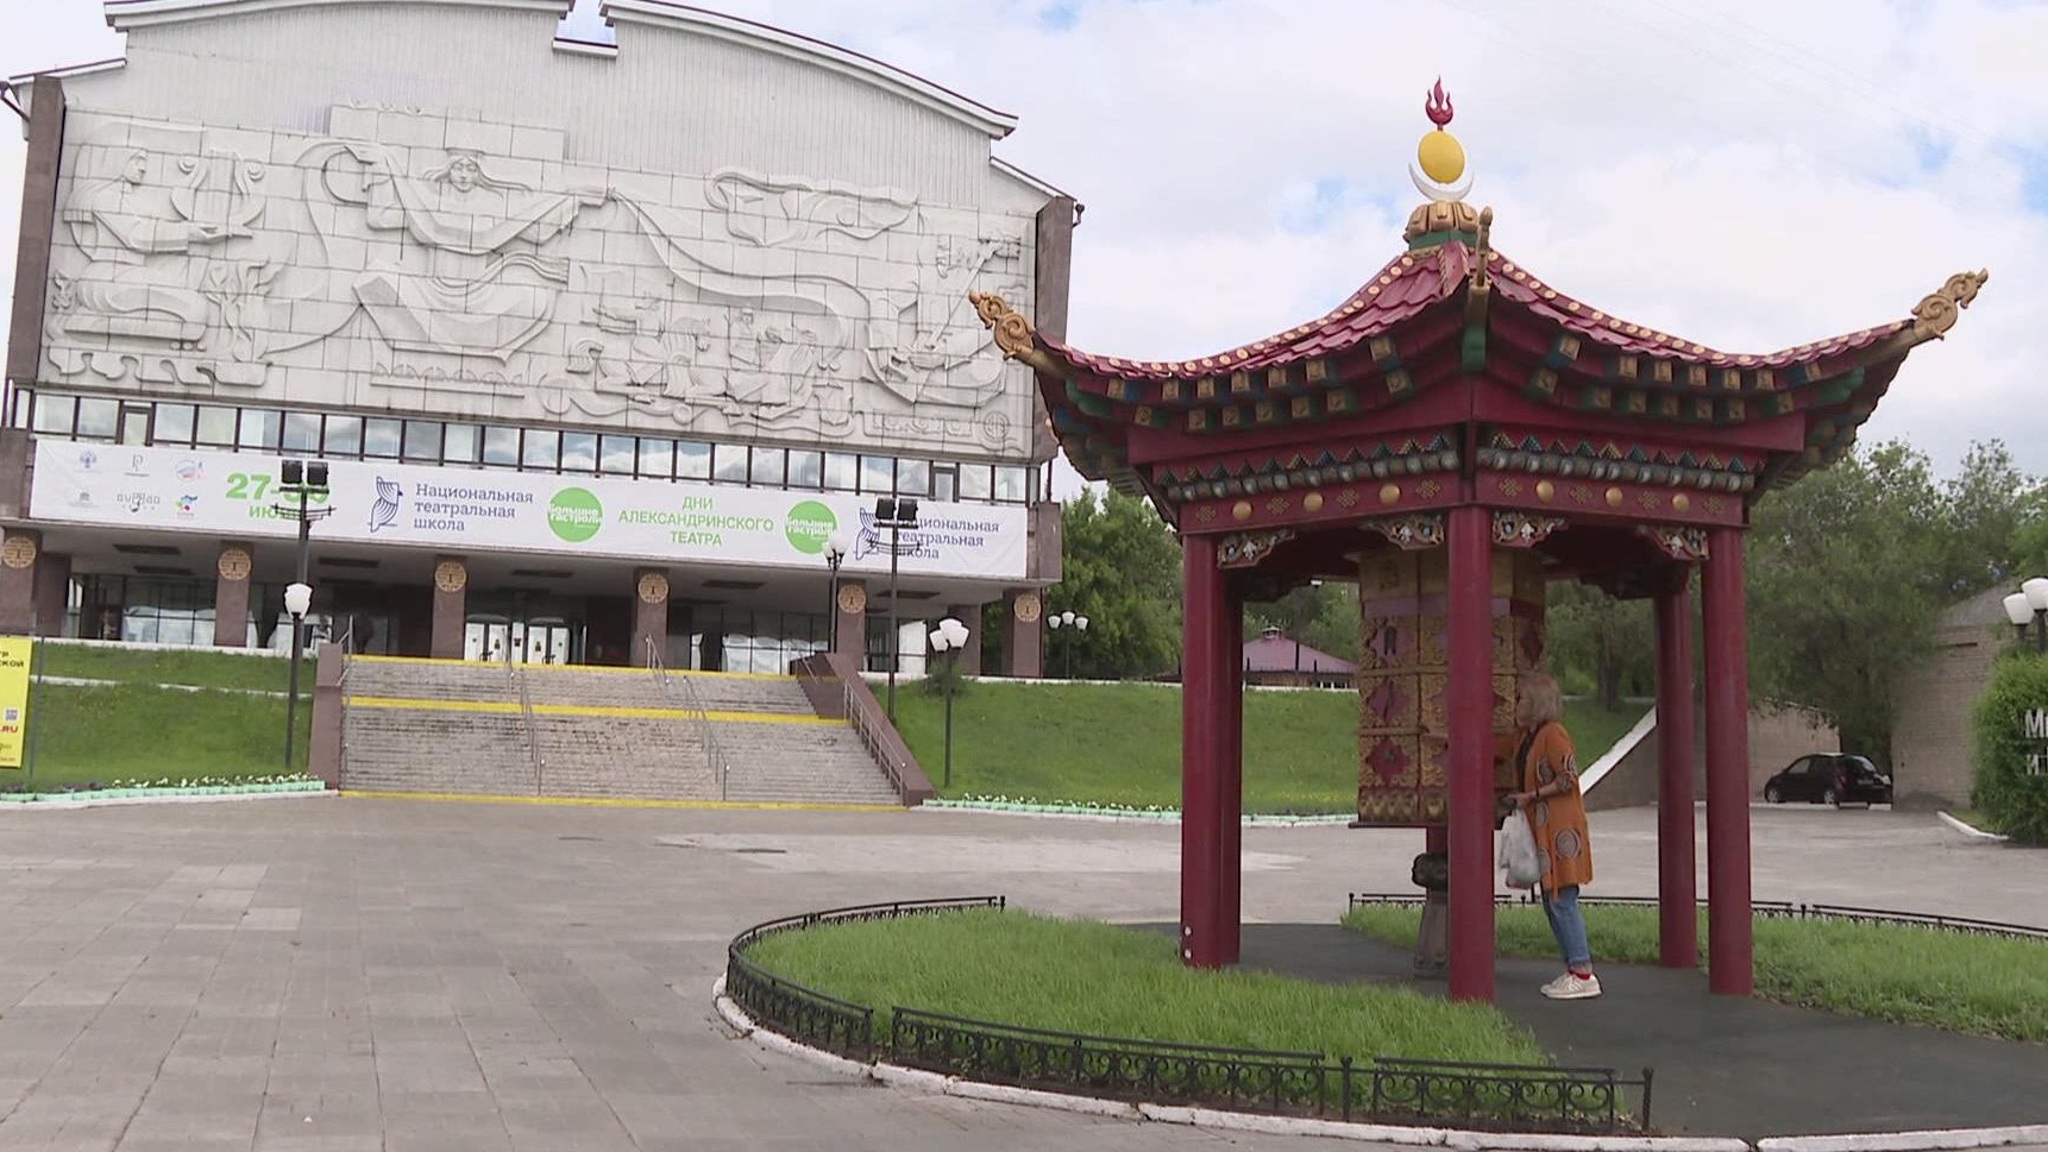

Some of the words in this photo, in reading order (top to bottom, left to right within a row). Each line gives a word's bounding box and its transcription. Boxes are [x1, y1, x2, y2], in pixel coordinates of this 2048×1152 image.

[415, 483, 534, 503] Национальная
[414, 501, 516, 518] театральная
[682, 496, 713, 510] ДНИ
[413, 518, 465, 531] школа
[618, 509, 774, 532] АЛЕКСАНДРИНСКОГО
[898, 518, 999, 533] циональная
[670, 531, 722, 546] ТЕАТРА
